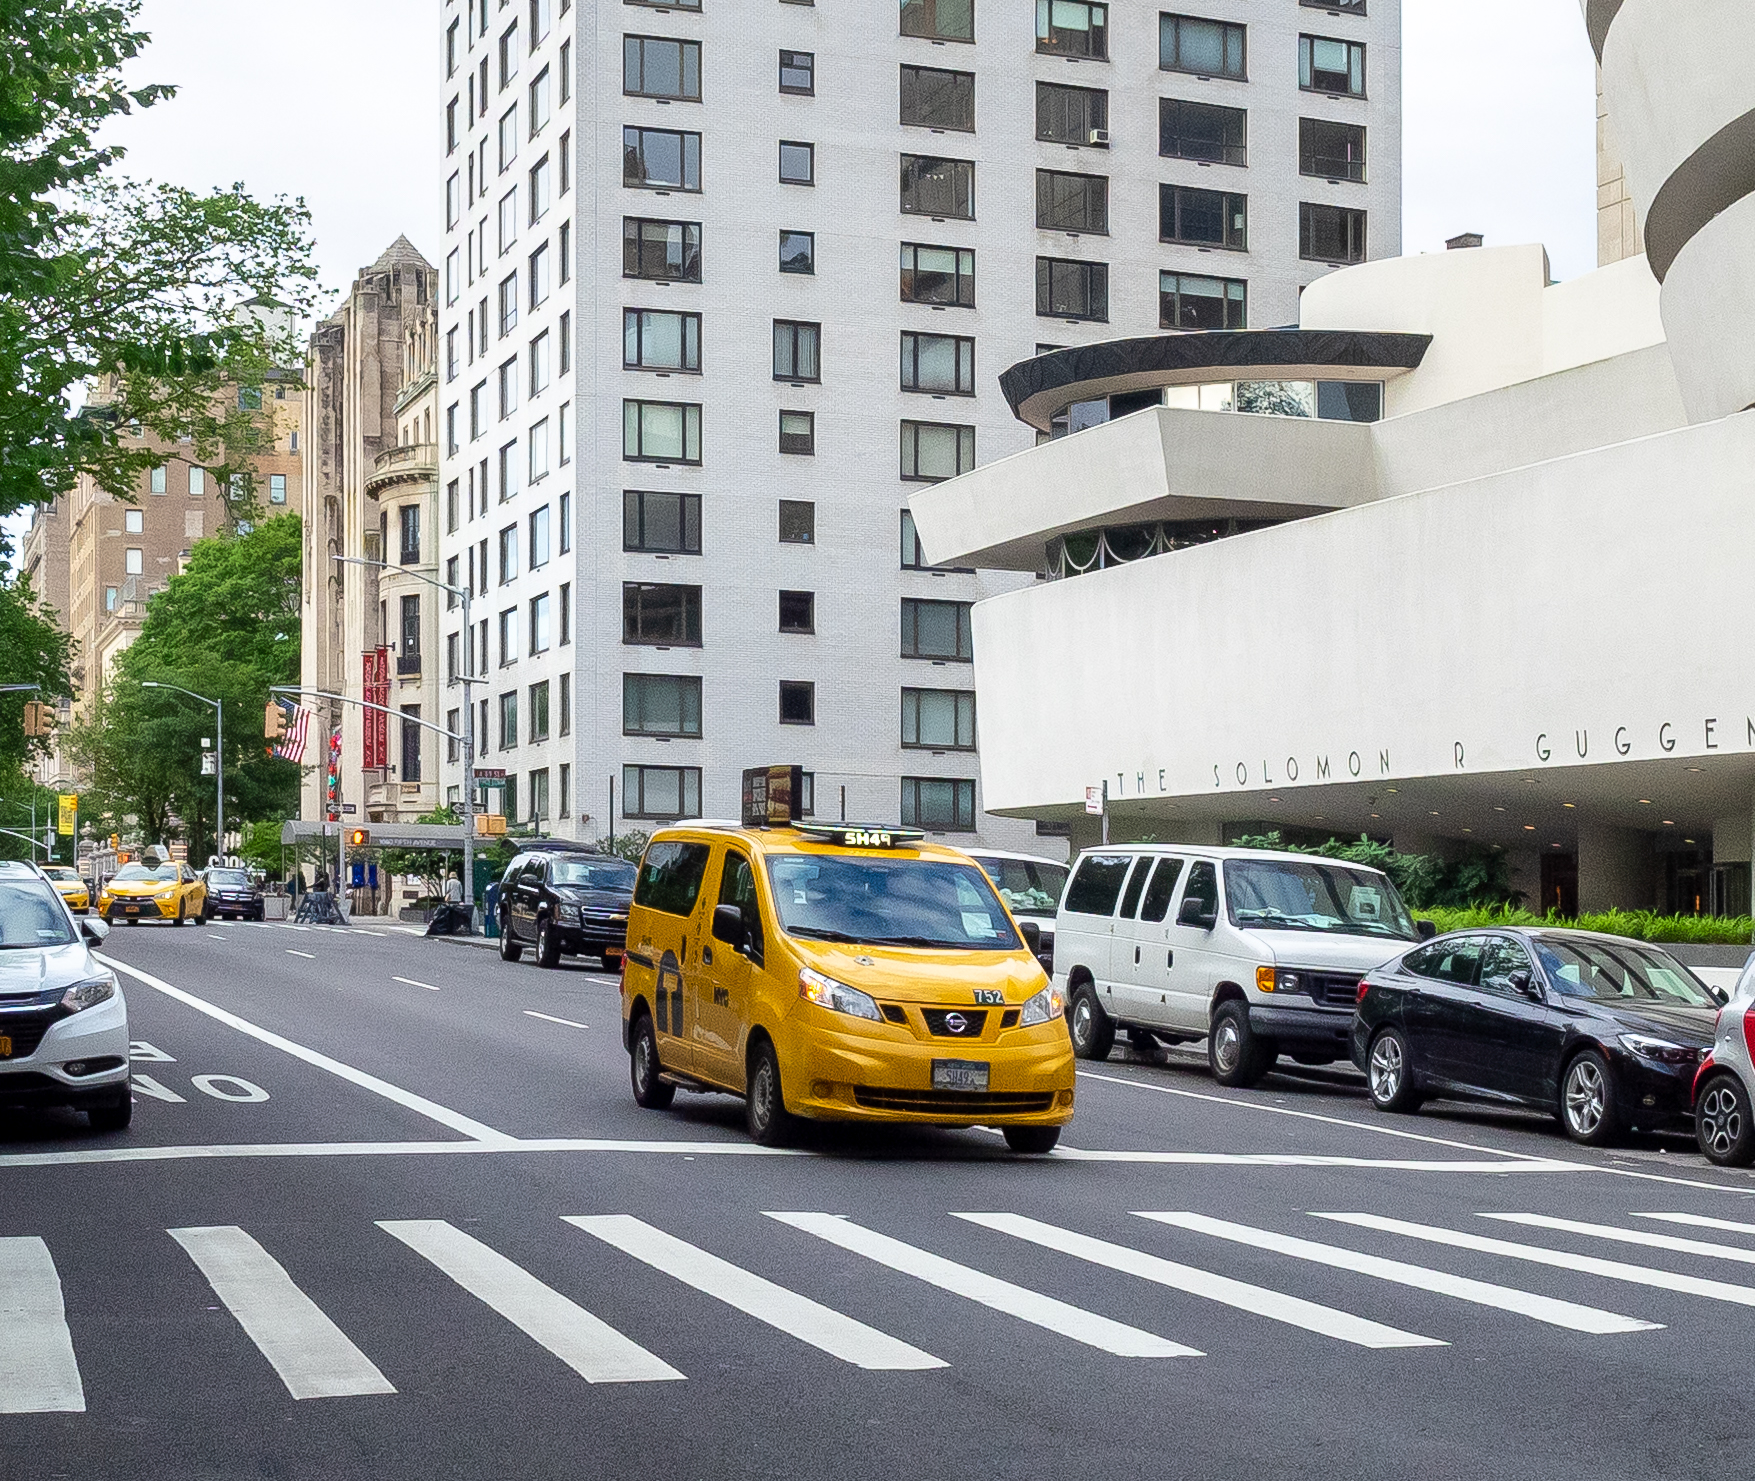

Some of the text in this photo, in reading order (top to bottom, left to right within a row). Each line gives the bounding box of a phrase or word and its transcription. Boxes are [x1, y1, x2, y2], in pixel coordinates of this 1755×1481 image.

[1117, 769, 1166, 795] THE
[1213, 749, 1391, 787] SOLOMON
[1454, 742, 1464, 768] R
[974, 989, 1004, 1004] 752
